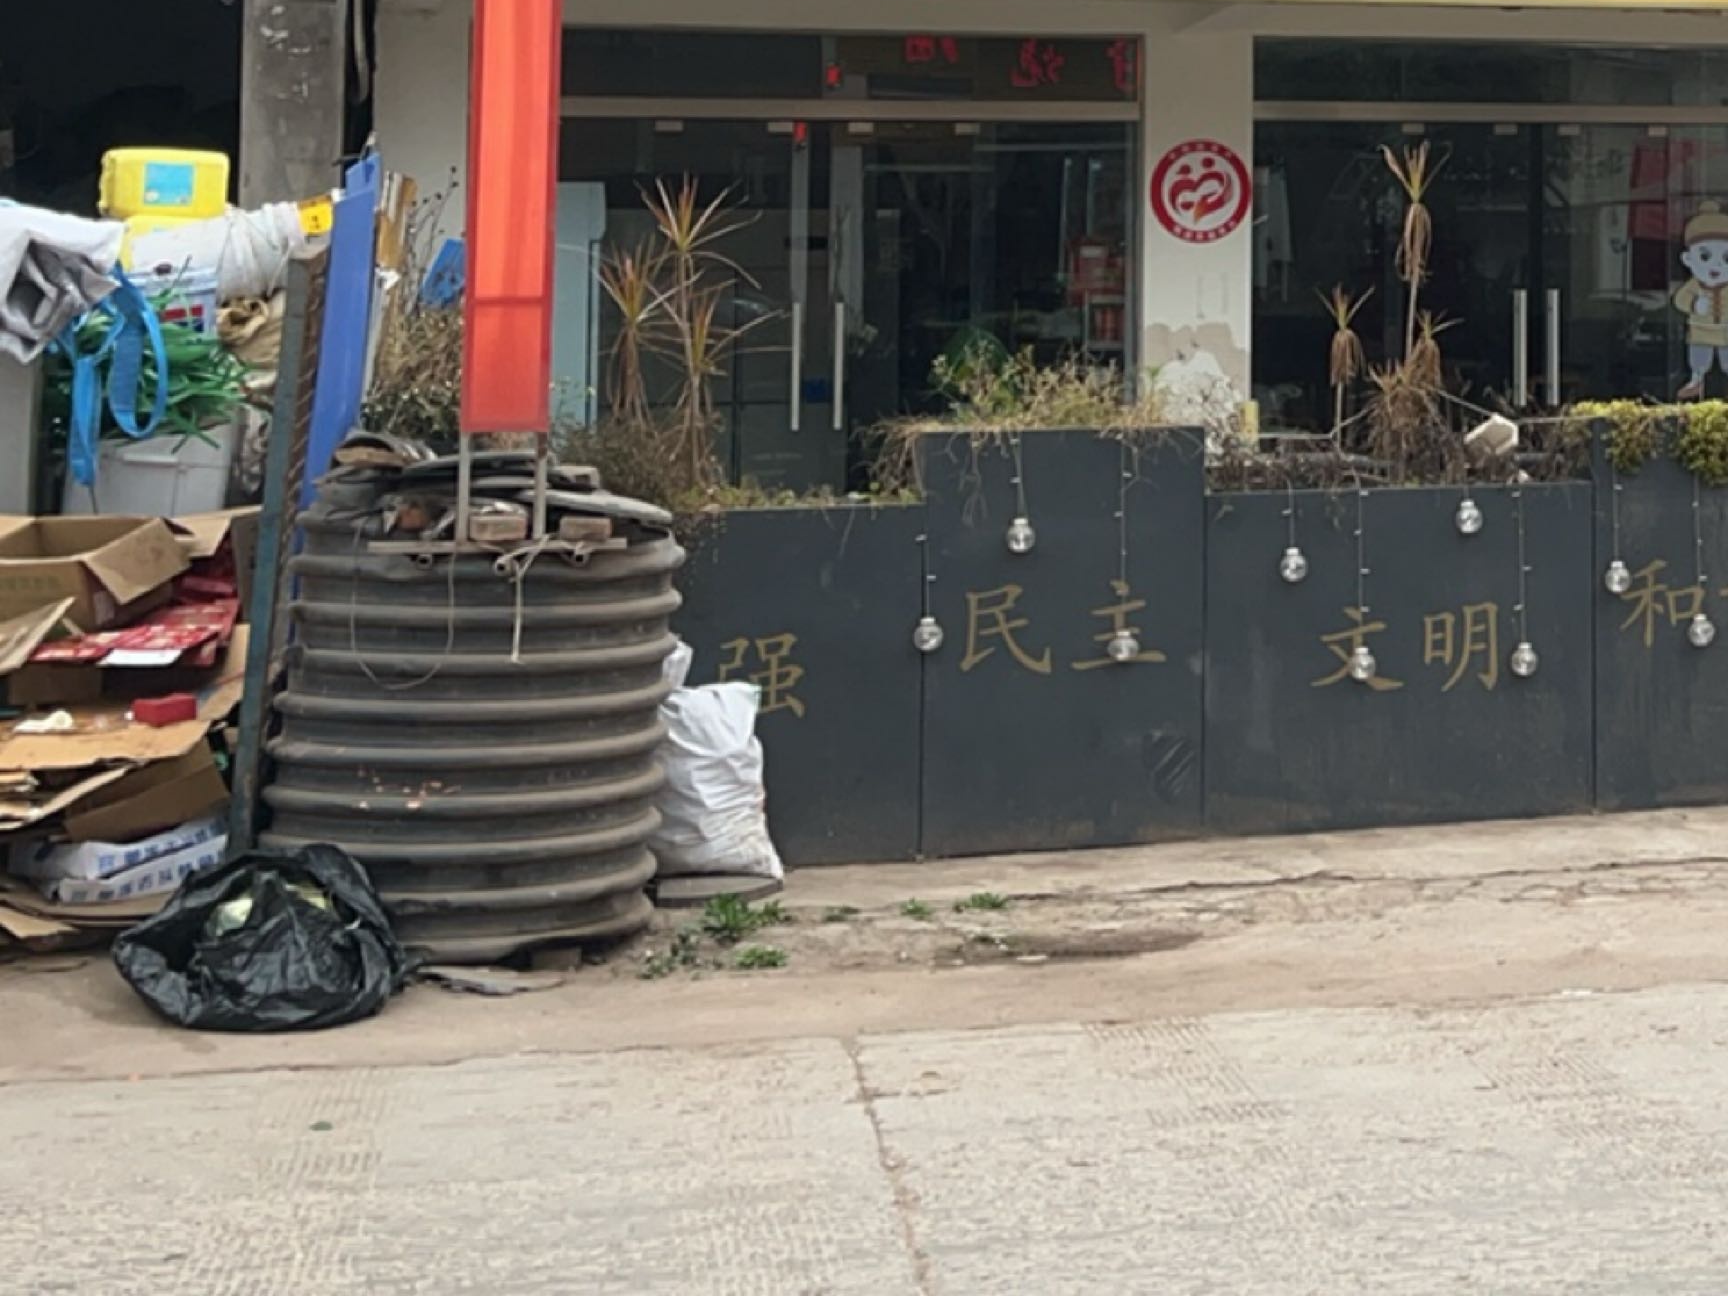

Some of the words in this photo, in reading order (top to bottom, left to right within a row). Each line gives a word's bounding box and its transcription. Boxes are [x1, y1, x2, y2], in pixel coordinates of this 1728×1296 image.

[959, 579, 1167, 674] 民主
[1309, 601, 1500, 692] 文明
[716, 632, 806, 718] 强
